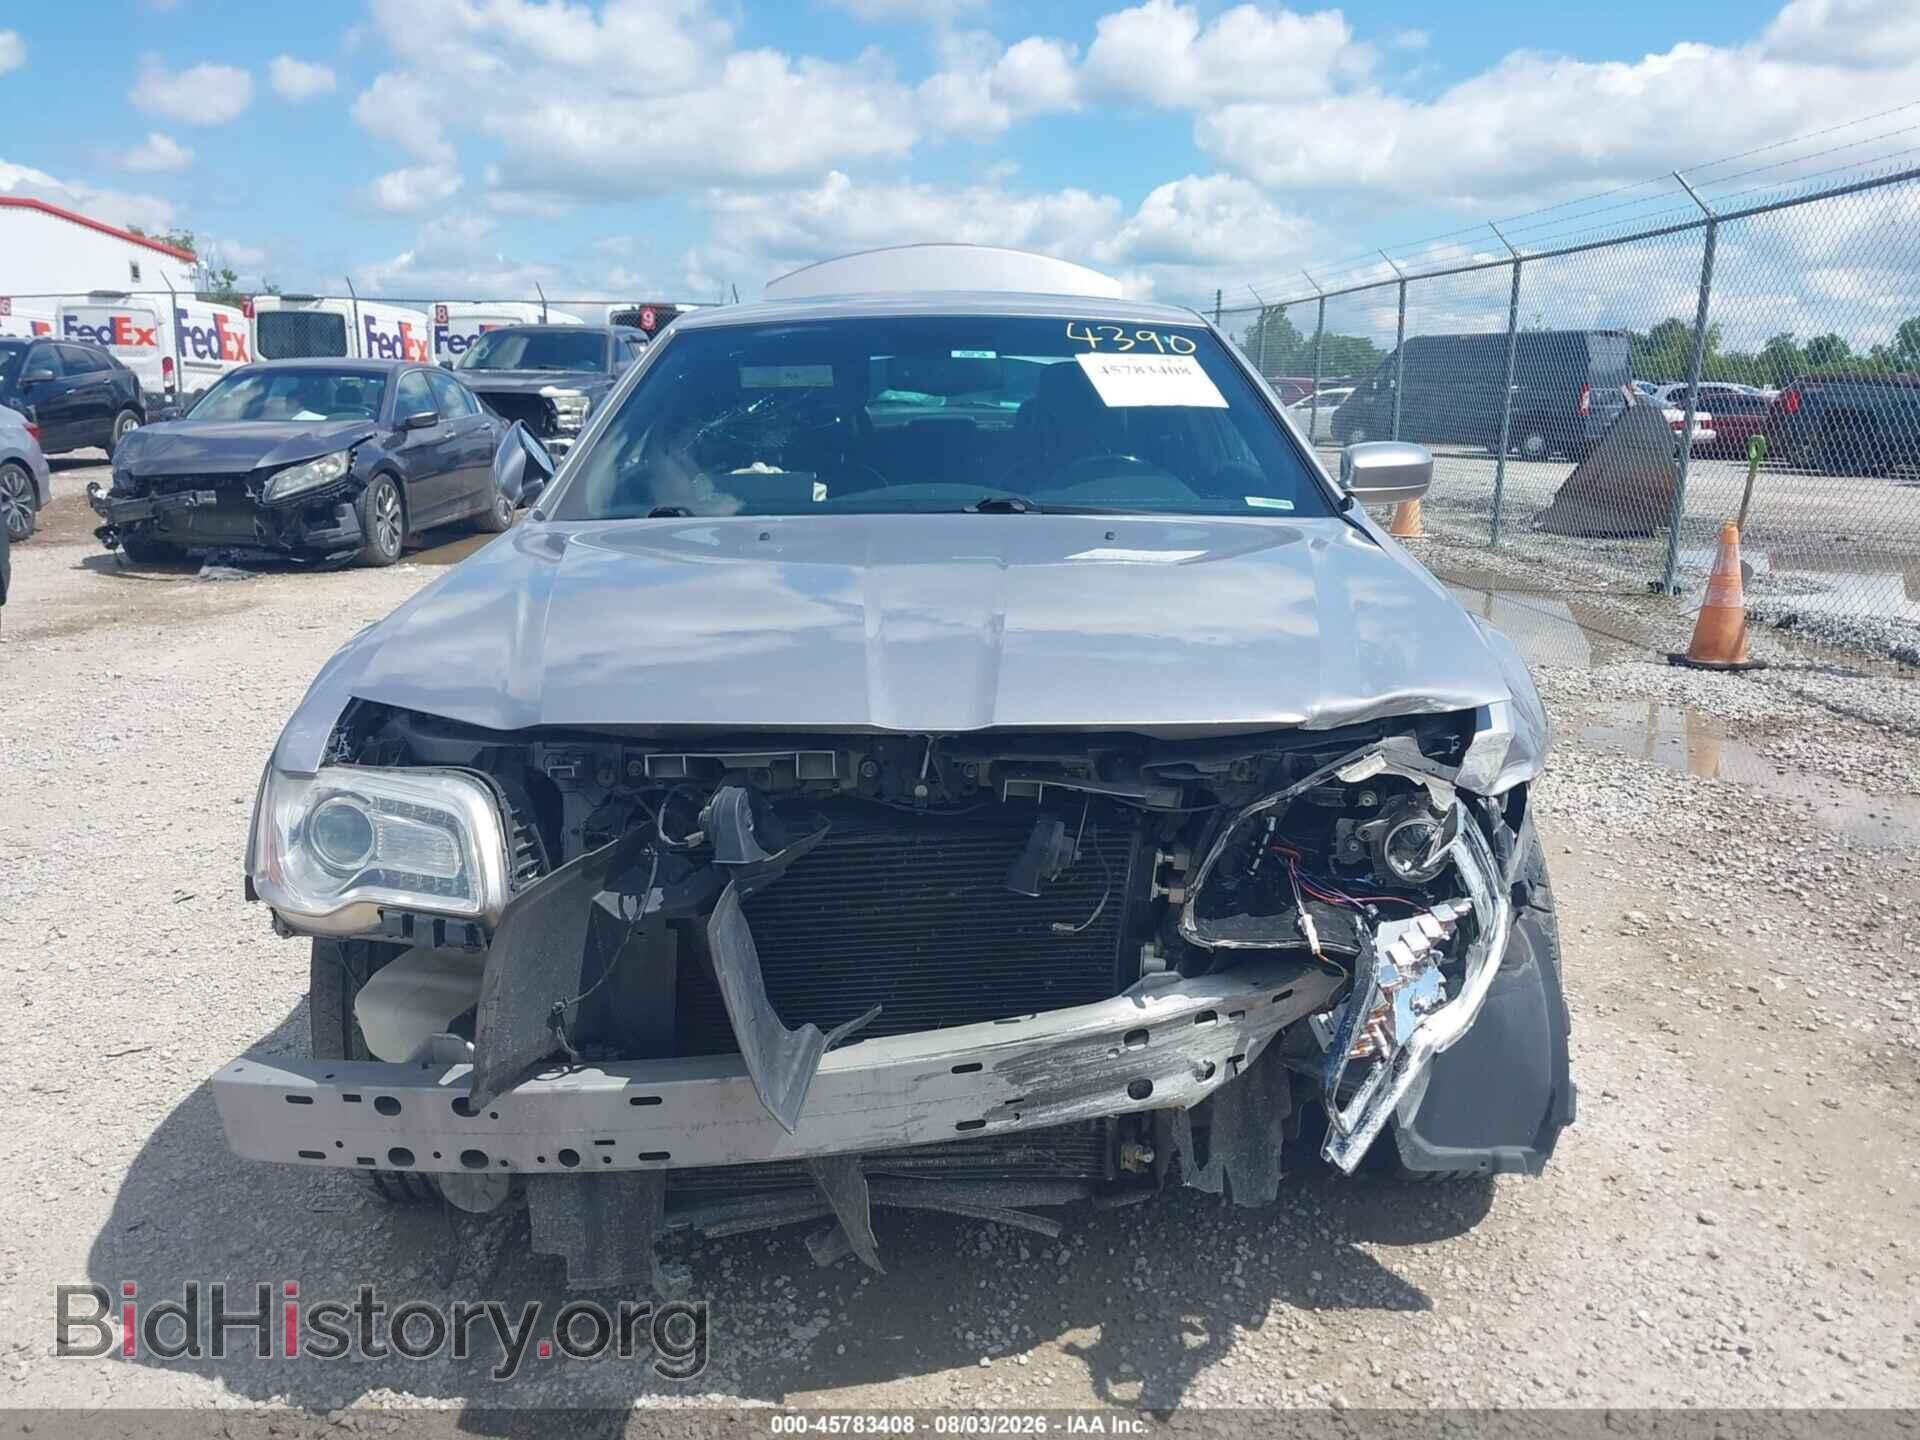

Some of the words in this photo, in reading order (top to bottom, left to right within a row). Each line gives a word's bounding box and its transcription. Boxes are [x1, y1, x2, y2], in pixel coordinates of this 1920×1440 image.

[63, 315, 157, 346] FedEx
[175, 308, 249, 363] FedEx
[642, 310, 655, 328] 9
[364, 312, 429, 363] FedEx
[1066, 322, 1197, 355] 4390
